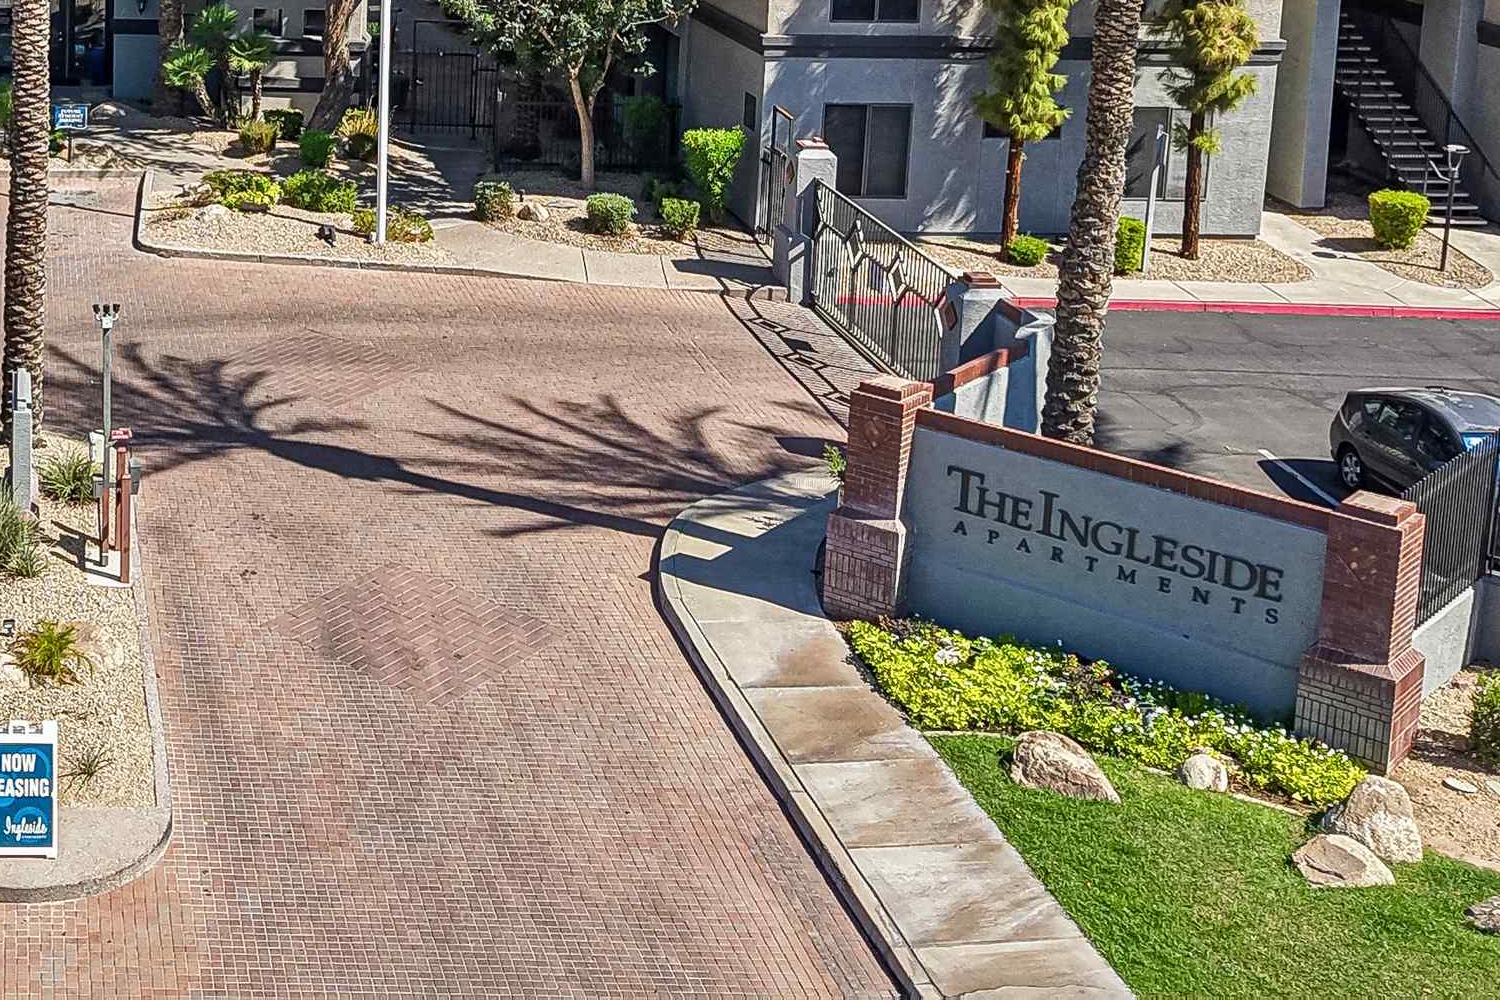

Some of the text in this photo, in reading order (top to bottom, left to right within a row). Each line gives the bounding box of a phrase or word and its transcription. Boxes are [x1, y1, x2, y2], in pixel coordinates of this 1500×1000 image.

[947, 465, 1284, 603] THE INGLESIDE
[953, 520, 1280, 625] APARTMENTS
[1, 753, 37, 773] NOW
[3, 815, 48, 841] Ingleside
